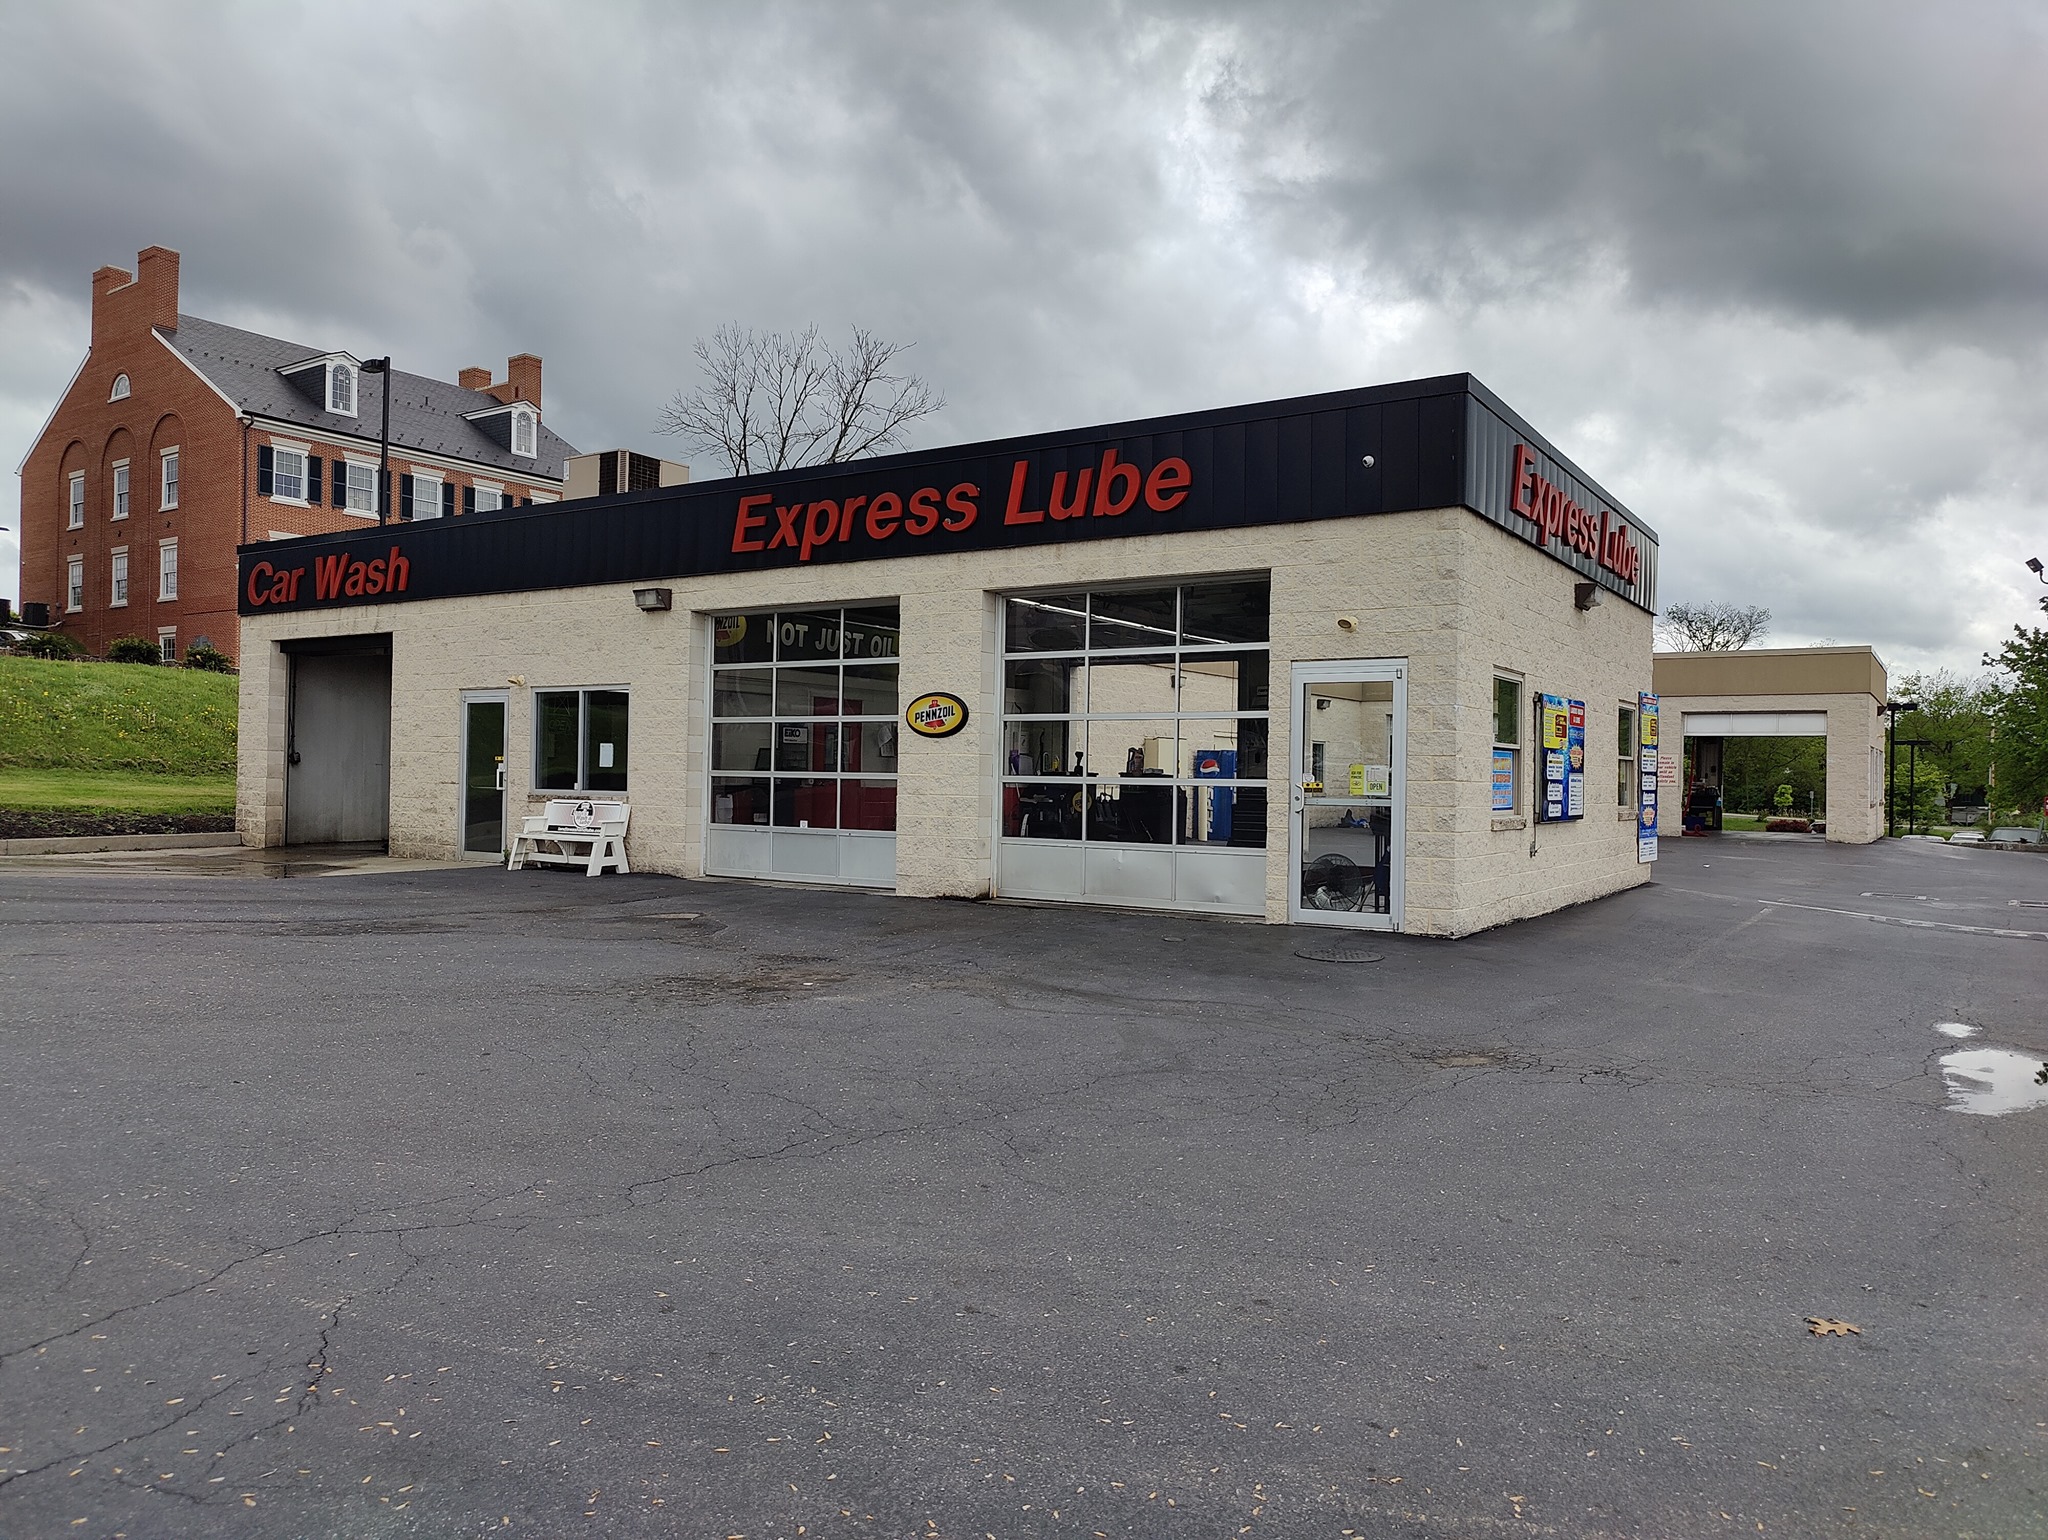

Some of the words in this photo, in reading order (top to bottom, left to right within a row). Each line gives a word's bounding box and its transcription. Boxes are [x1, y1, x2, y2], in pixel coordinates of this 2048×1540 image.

[731, 482, 980, 560] Express
[1003, 448, 1193, 526] Lube
[1510, 443, 1599, 559] Express
[1598, 510, 1640, 586] Lube
[247, 561, 305, 606] Car
[315, 545, 410, 600] Wash
[766, 620, 808, 648] NOT
[814, 628, 864, 655] JUST
[870, 635, 896, 657] OIL
[914, 705, 956, 723] PENNZOIL
[1369, 782, 1383, 791] OPEN
